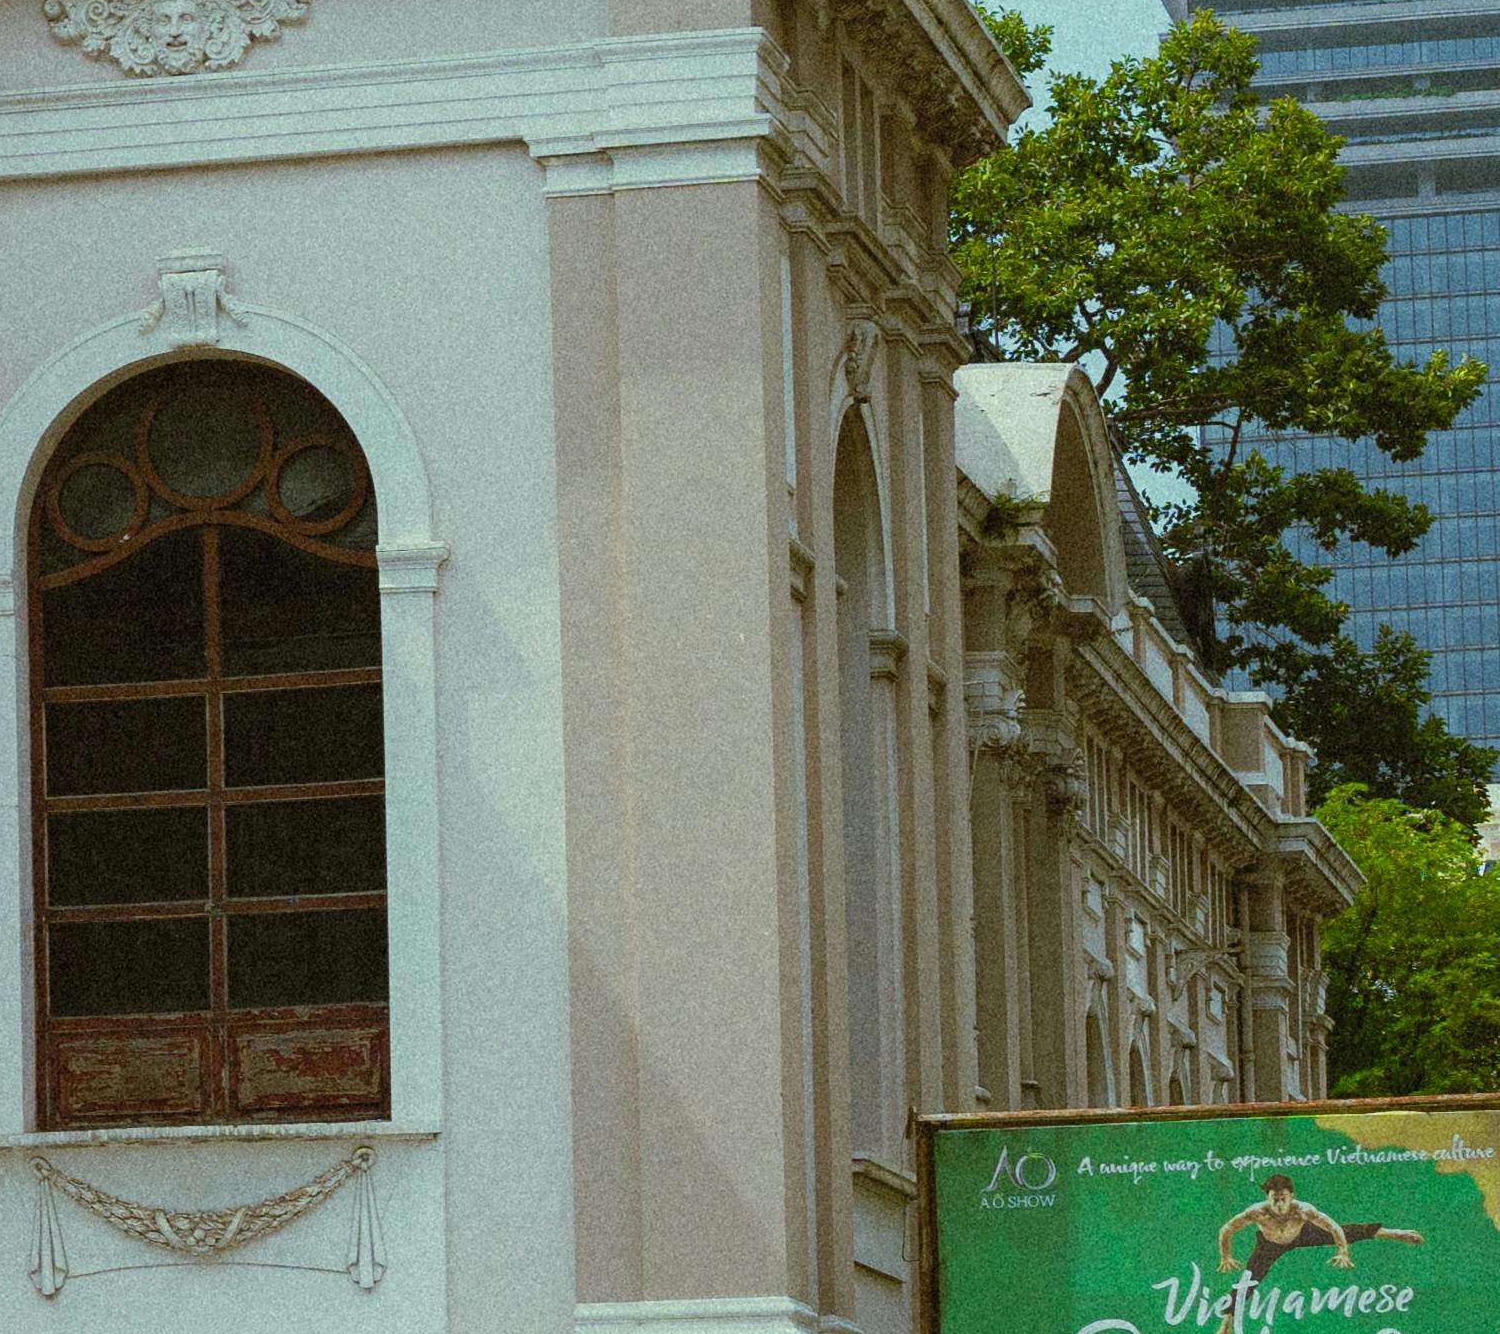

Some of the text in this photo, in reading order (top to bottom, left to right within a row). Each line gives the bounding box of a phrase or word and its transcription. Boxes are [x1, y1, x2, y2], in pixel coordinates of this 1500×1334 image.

[1077, 1133, 1494, 1185] A unique way to experience Vietnamese culture
[1007, 1194, 1056, 1209] SHOW
